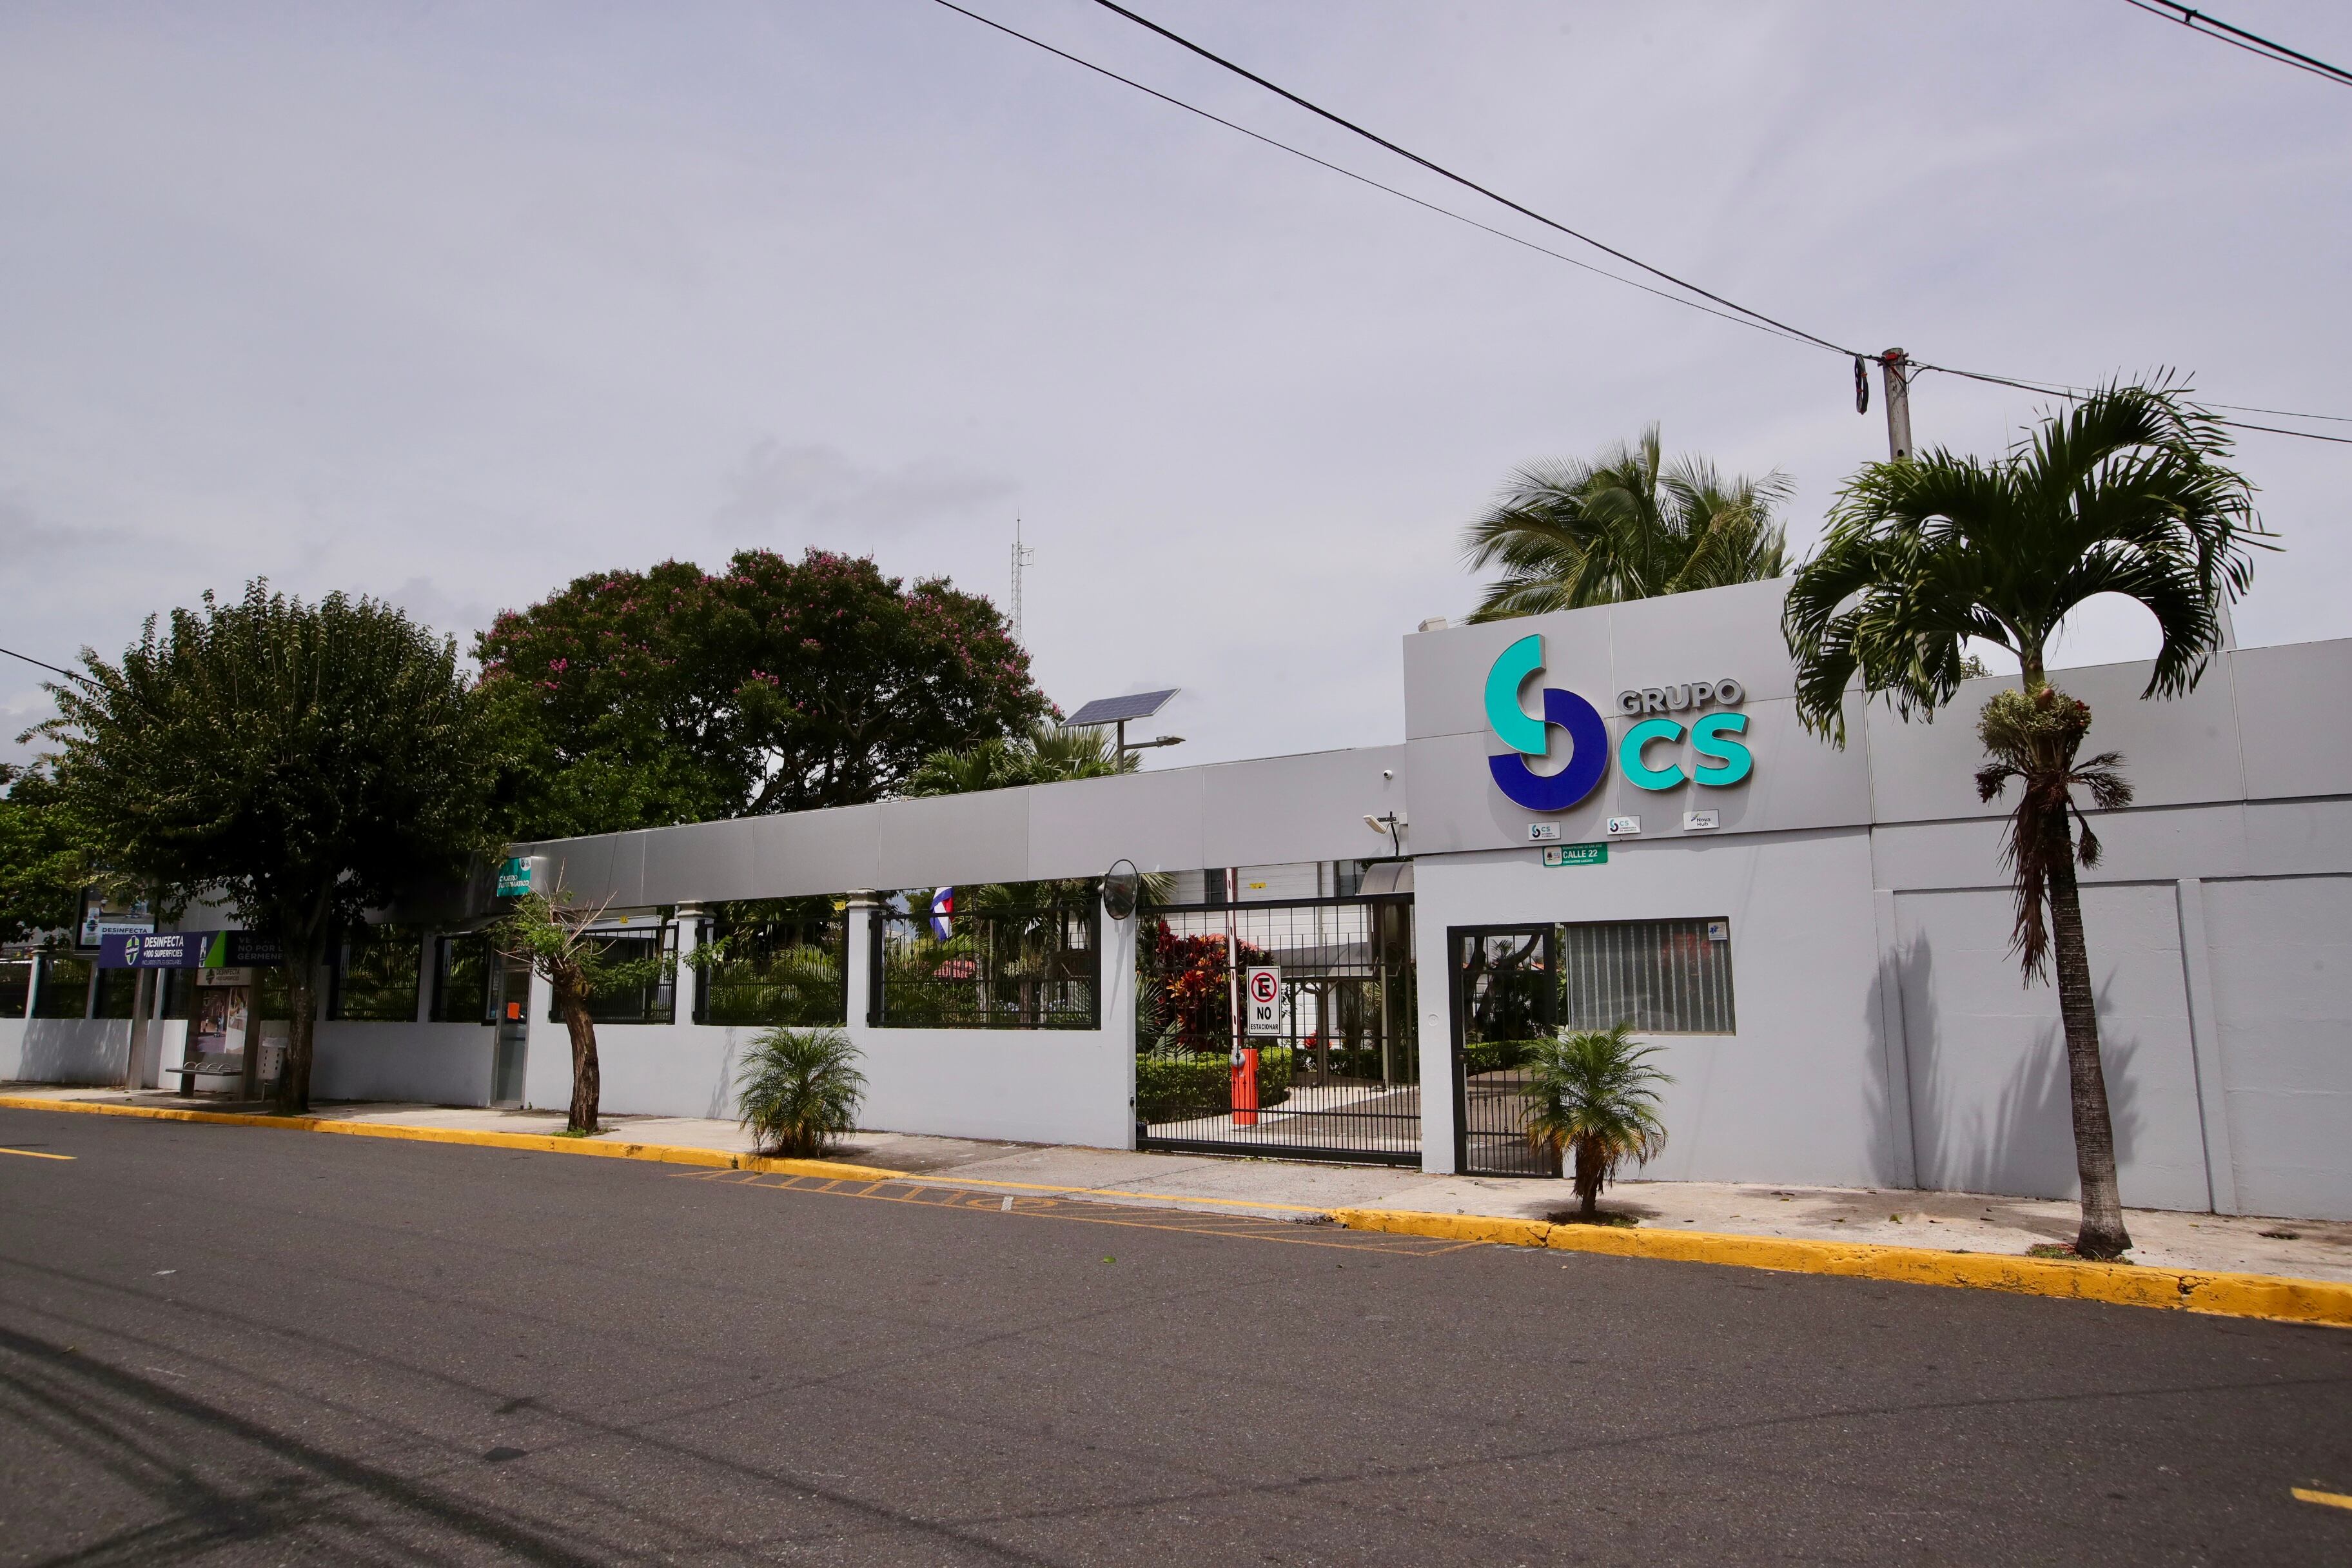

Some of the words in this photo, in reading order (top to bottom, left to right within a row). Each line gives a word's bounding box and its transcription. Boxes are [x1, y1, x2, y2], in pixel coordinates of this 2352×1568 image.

[1616, 678, 1745, 716] GRUPO
[1620, 712, 1754, 790] CS
[1563, 850, 1586, 859] CALLE
[1588, 849, 1598, 858] 22
[144, 936, 184, 948] DESINFECTA
[255, 944, 275, 952] POR
[154, 949, 183, 957] SUPERFICIES
[1257, 1006, 1271, 1020] NO
